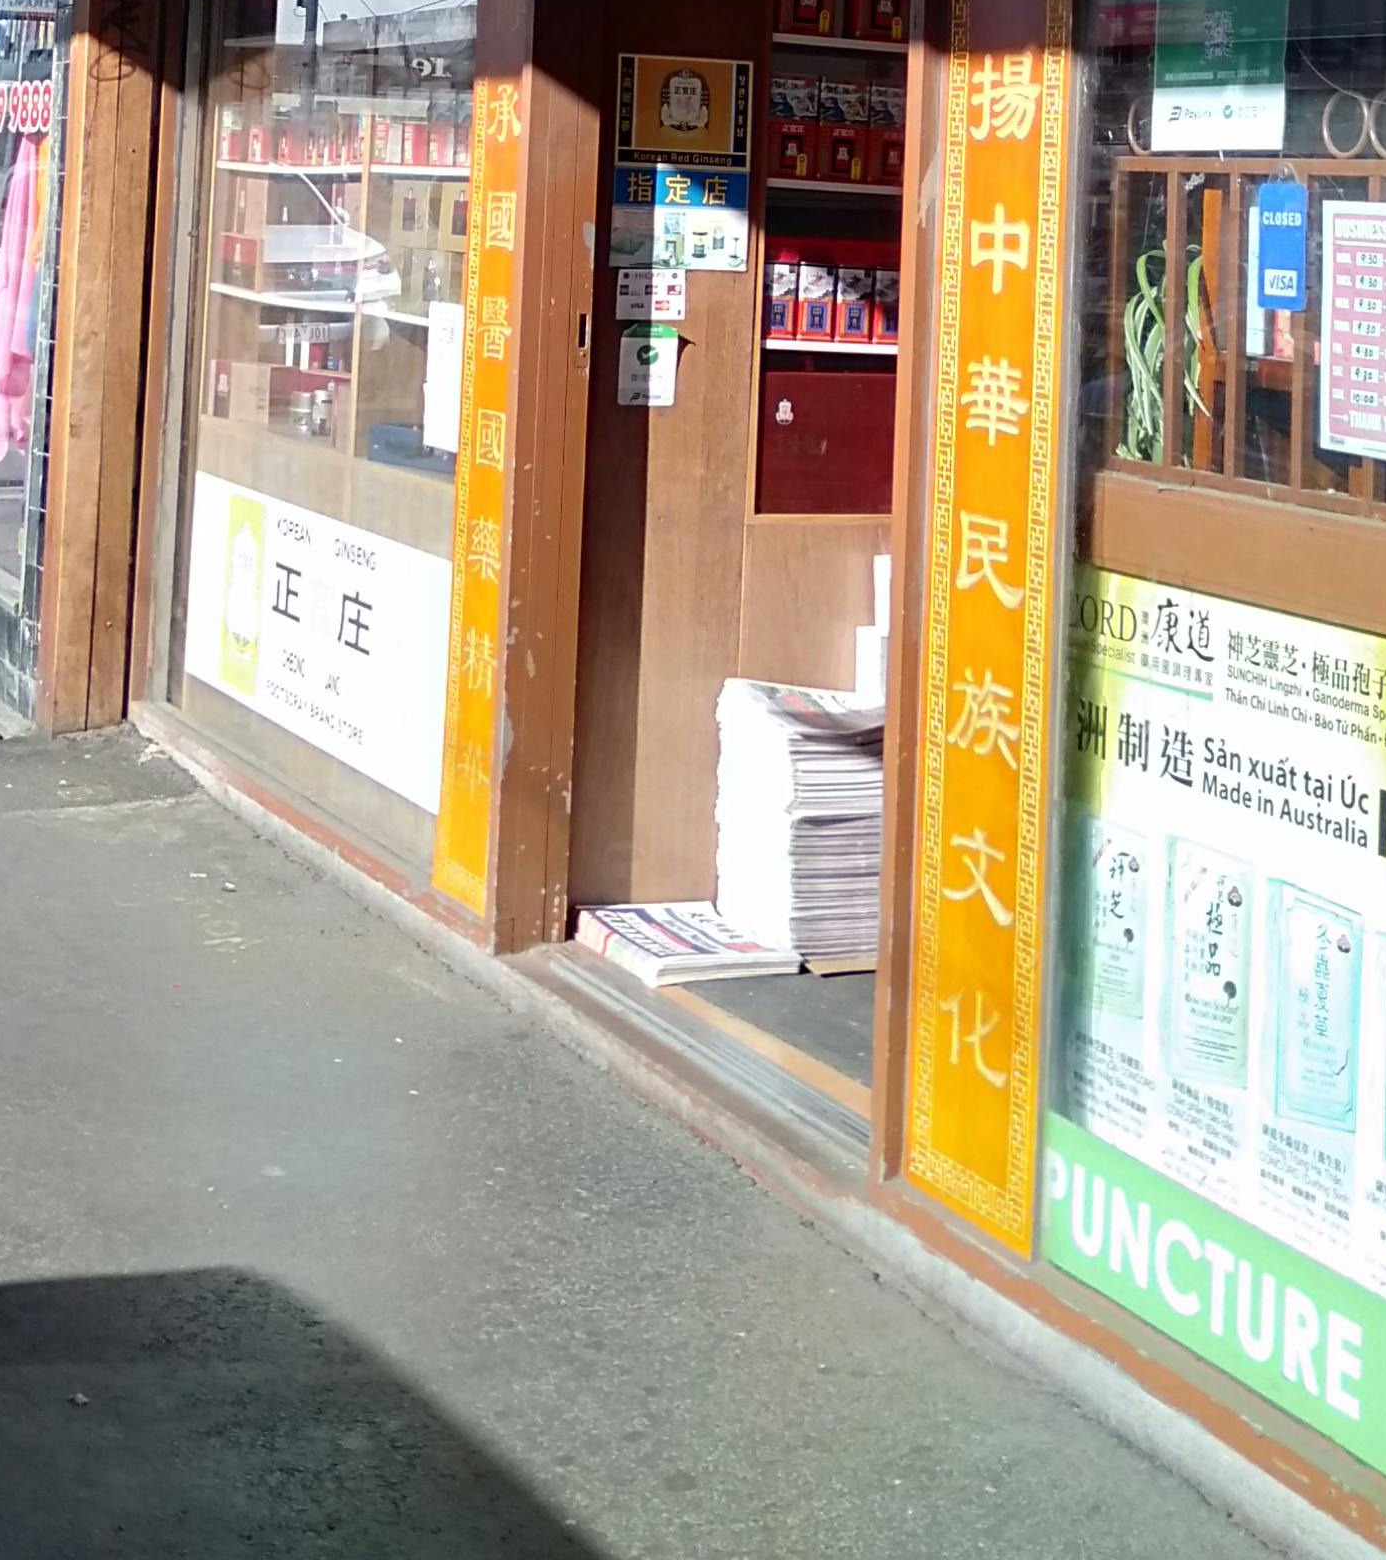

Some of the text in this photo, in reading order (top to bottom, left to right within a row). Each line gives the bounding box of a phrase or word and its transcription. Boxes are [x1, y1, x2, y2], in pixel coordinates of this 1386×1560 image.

[8, 79, 53, 133] 9888
[634, 151, 732, 166] Korean Red Ginseng
[627, 172, 728, 205] 指定店
[1263, 211, 1301, 226] CLOSED
[1265, 275, 1295, 292] VISA
[1348, 411, 1383, 430] THANK
[272, 561, 372, 656] 正庄
[1227, 666, 1267, 687] SUNCHIH
[1270, 678, 1302, 698] Lingzhi
[1313, 689, 1370, 717] Ganoderma
[1268, 701, 1289, 718] Linh
[1204, 736, 1369, 815] Sản xuất tại Úc
[1203, 773, 1369, 849] Made in Australia
